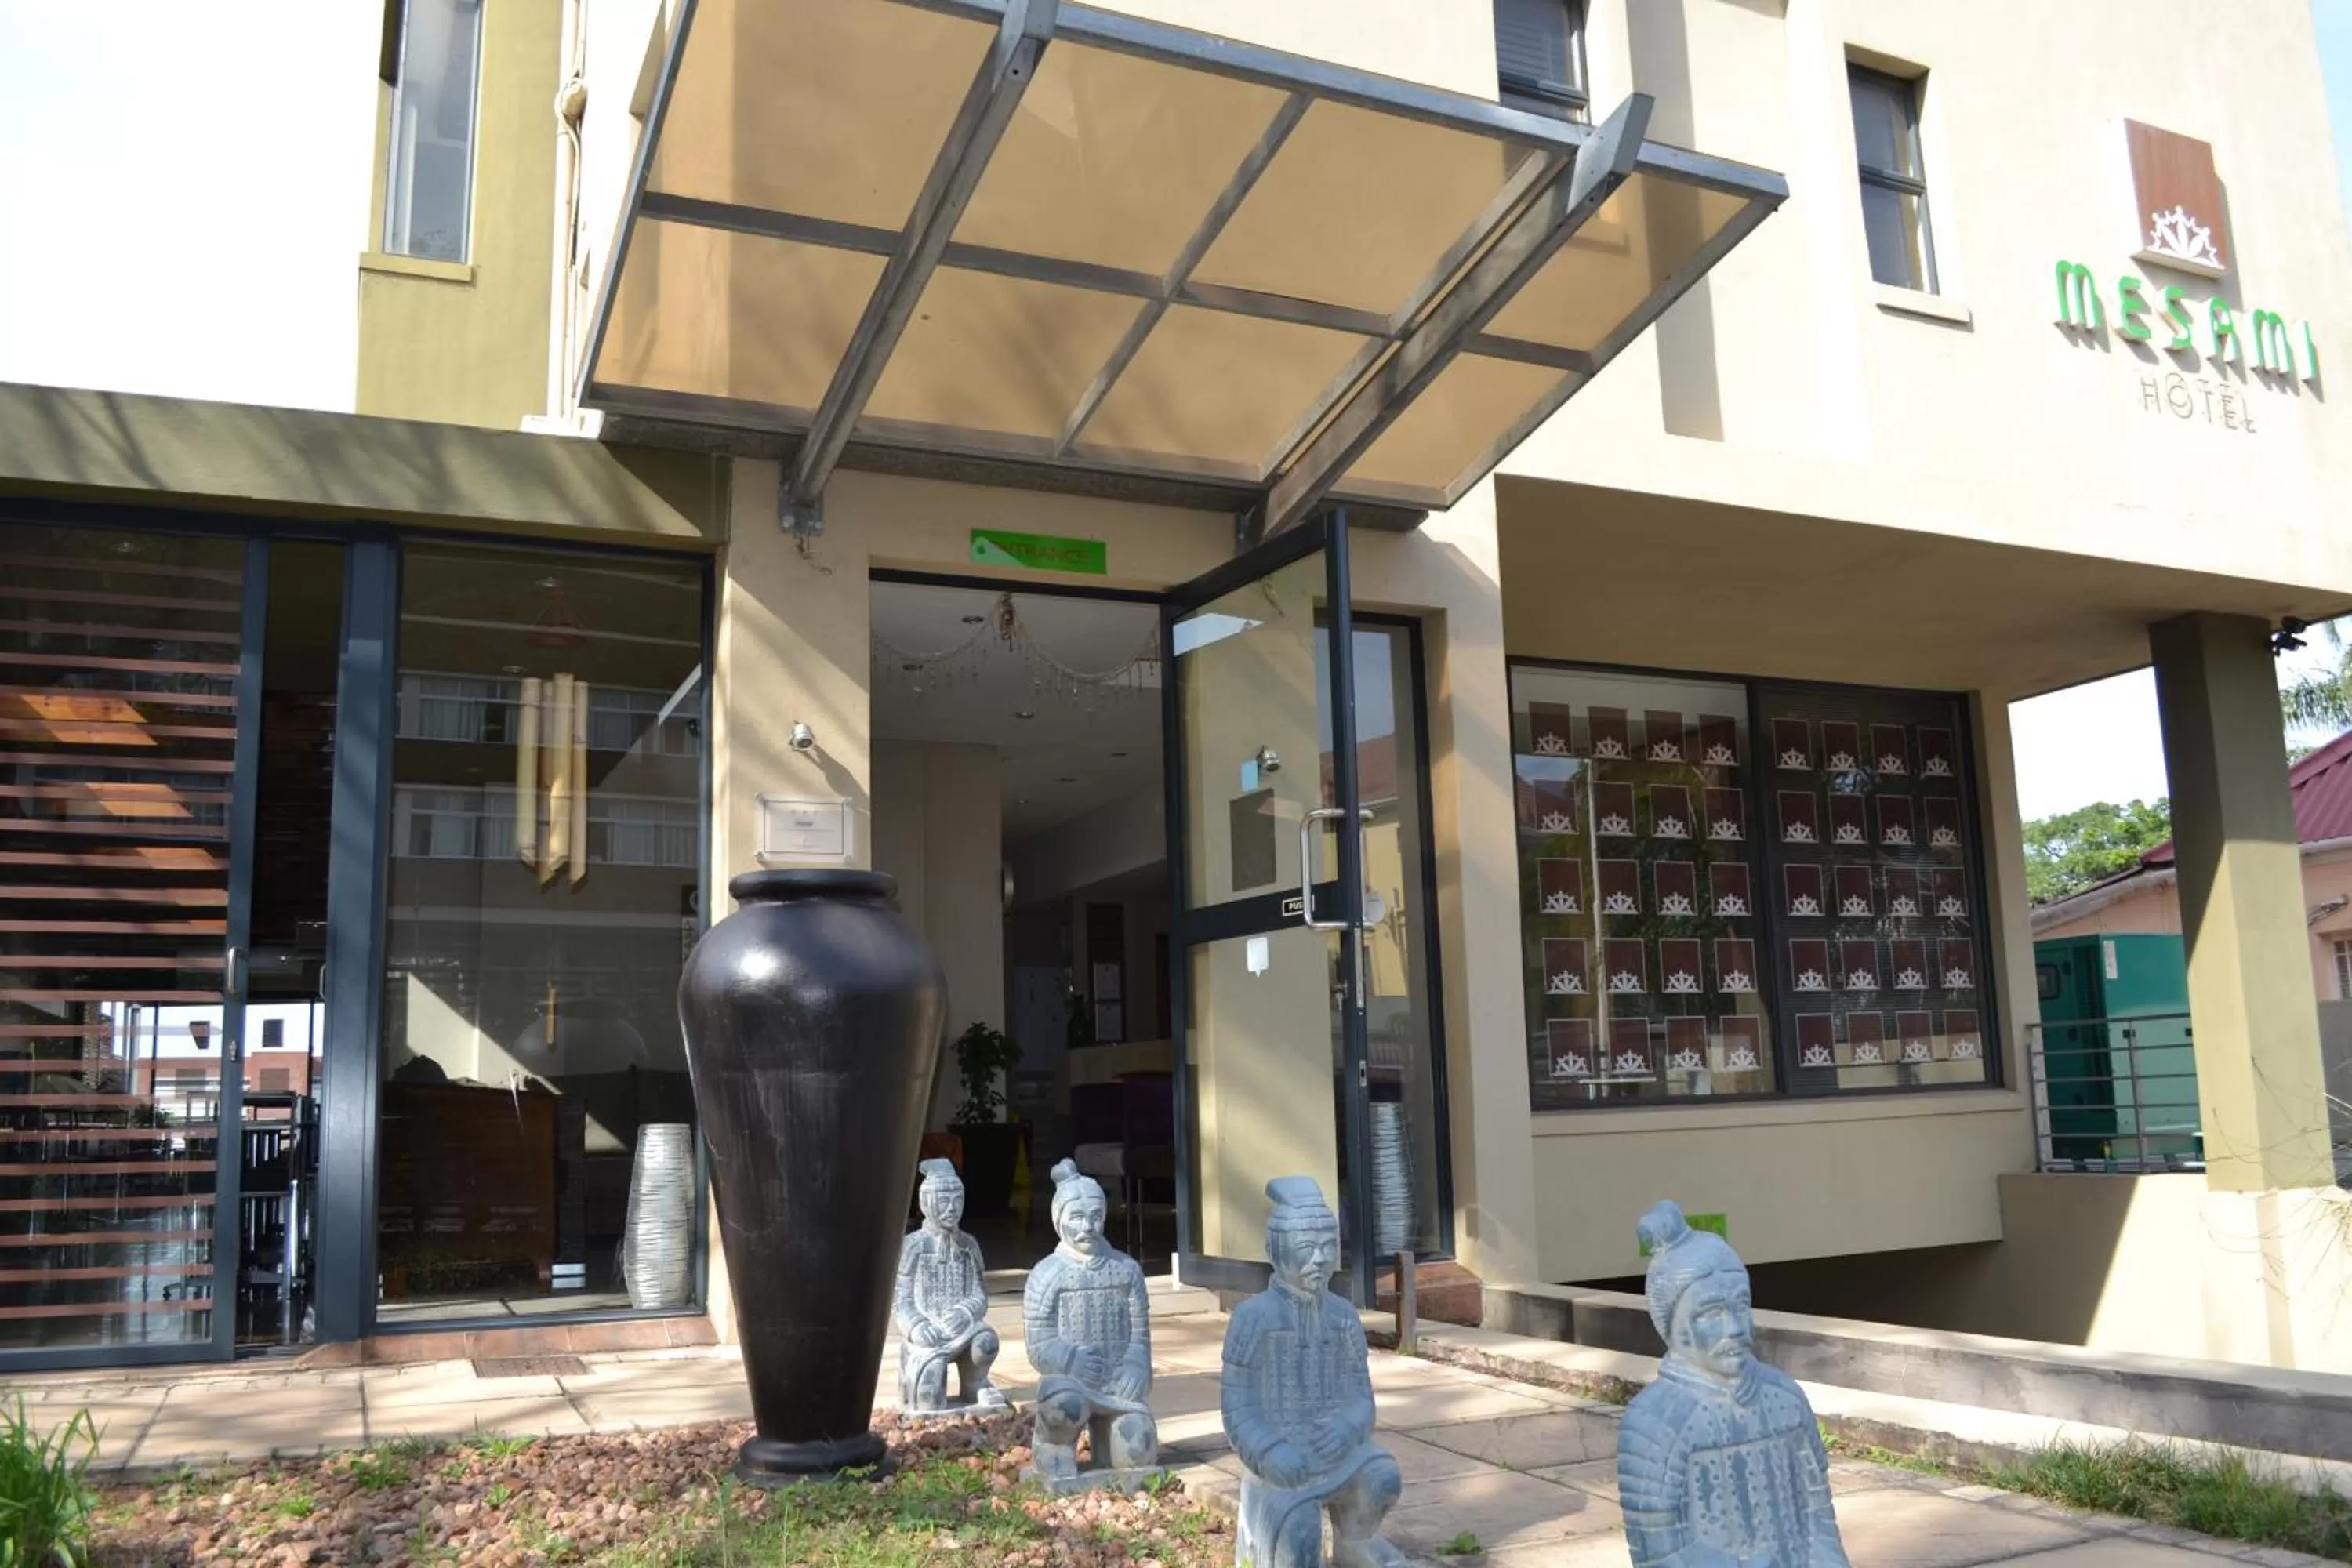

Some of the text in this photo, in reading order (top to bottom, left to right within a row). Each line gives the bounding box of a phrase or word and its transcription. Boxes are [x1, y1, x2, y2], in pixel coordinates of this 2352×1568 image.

[2053, 260, 2317, 381] MESAMI
[2140, 372, 2258, 434] HOTEL
[990, 541, 1091, 564] NTRANCE
[1288, 902, 1304, 911] PUS
